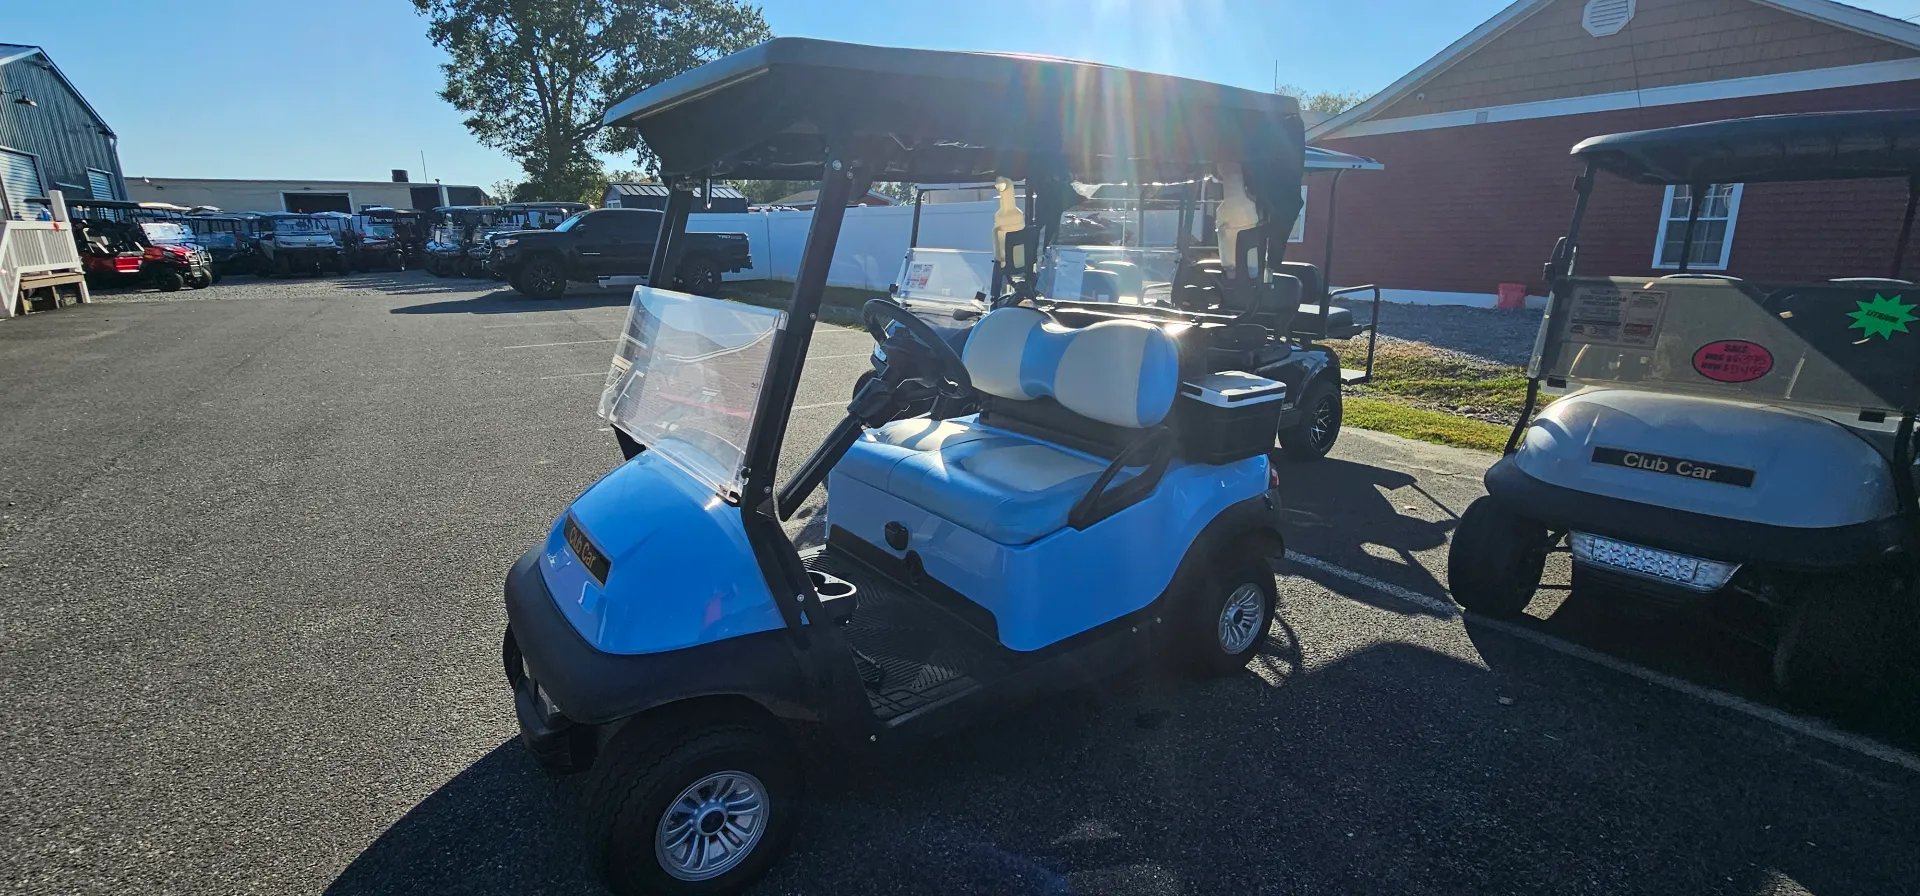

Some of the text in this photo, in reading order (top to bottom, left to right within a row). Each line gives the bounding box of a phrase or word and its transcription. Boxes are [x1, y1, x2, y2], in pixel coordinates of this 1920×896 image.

[1623, 453, 1716, 479] Club Car
[570, 526, 597, 568] Club Car
